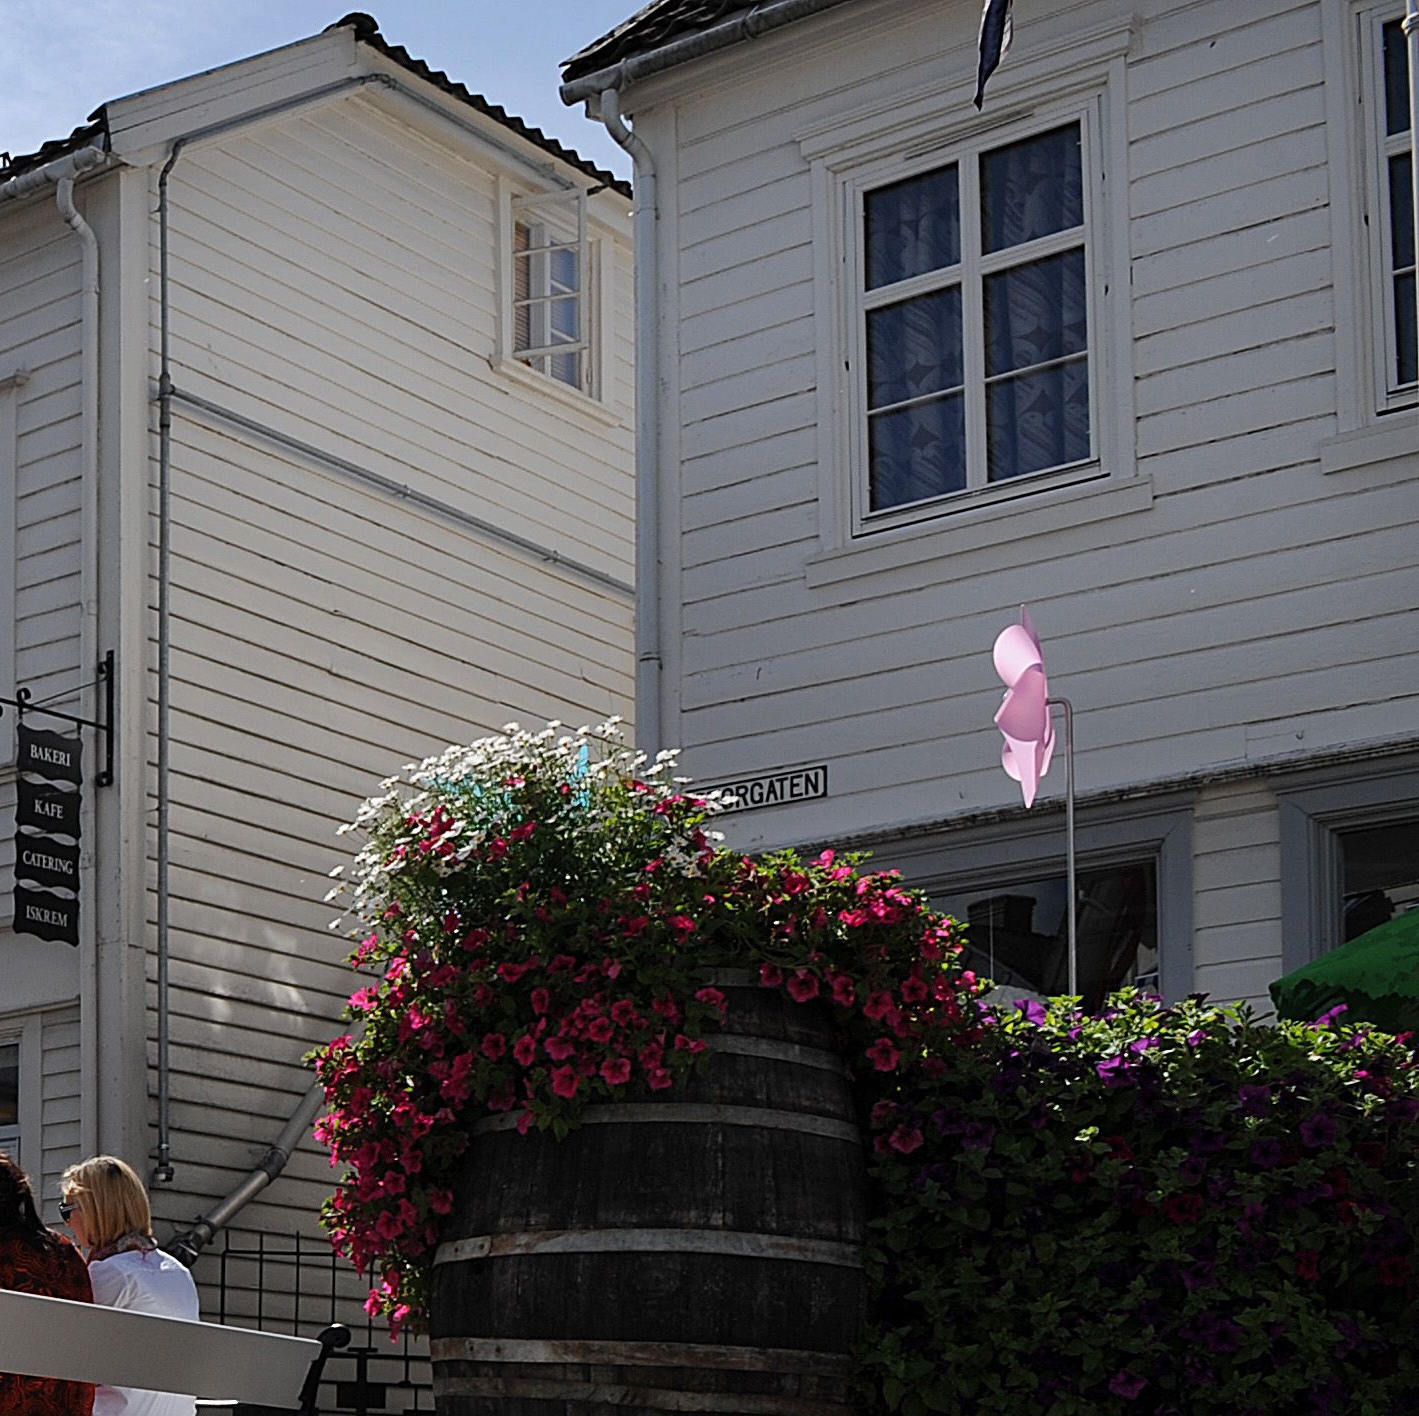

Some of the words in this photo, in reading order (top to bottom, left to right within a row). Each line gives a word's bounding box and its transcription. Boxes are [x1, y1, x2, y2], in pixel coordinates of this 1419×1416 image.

[30, 744, 71, 767] BAKERI
[34, 800, 64, 819] KAFE
[22, 850, 74, 875] CATERING
[25, 904, 68, 928] ISKREM
